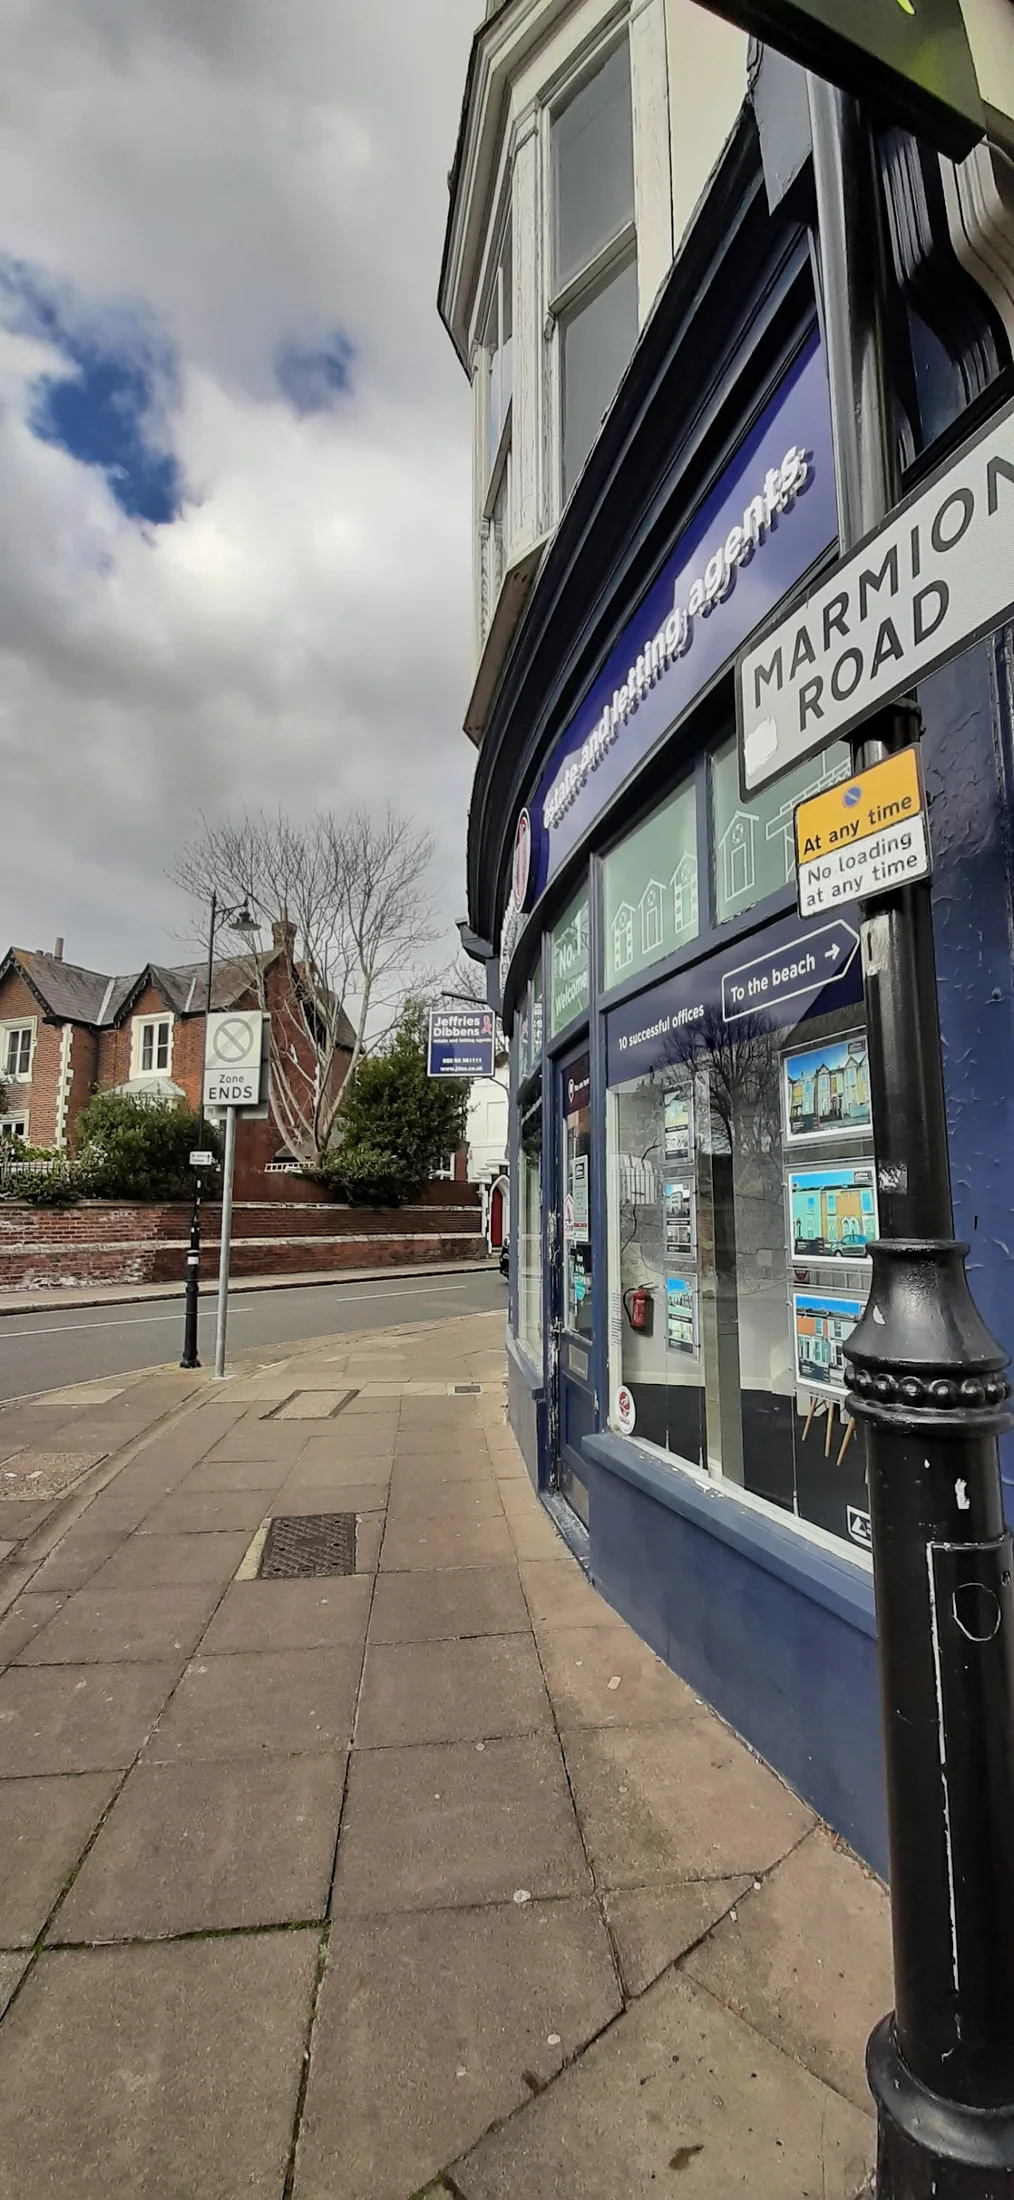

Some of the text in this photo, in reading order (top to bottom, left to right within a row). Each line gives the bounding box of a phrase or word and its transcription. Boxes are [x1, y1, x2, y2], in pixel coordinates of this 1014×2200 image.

[543, 445, 809, 830] estate and letting agents
[799, 580, 950, 733] ROAD
[803, 796, 912, 855] At any time
[806, 854, 918, 907] at any time
[808, 832, 912, 886] No loading
[730, 953, 816, 1003] To the beach
[433, 1027, 480, 1037] Dibbens
[434, 1015, 481, 1027] Jeffries
[618, 1003, 705, 1050] 10 successful offices
[208, 1086, 253, 1100] ENDS
[219, 1074, 244, 1083] Zone
